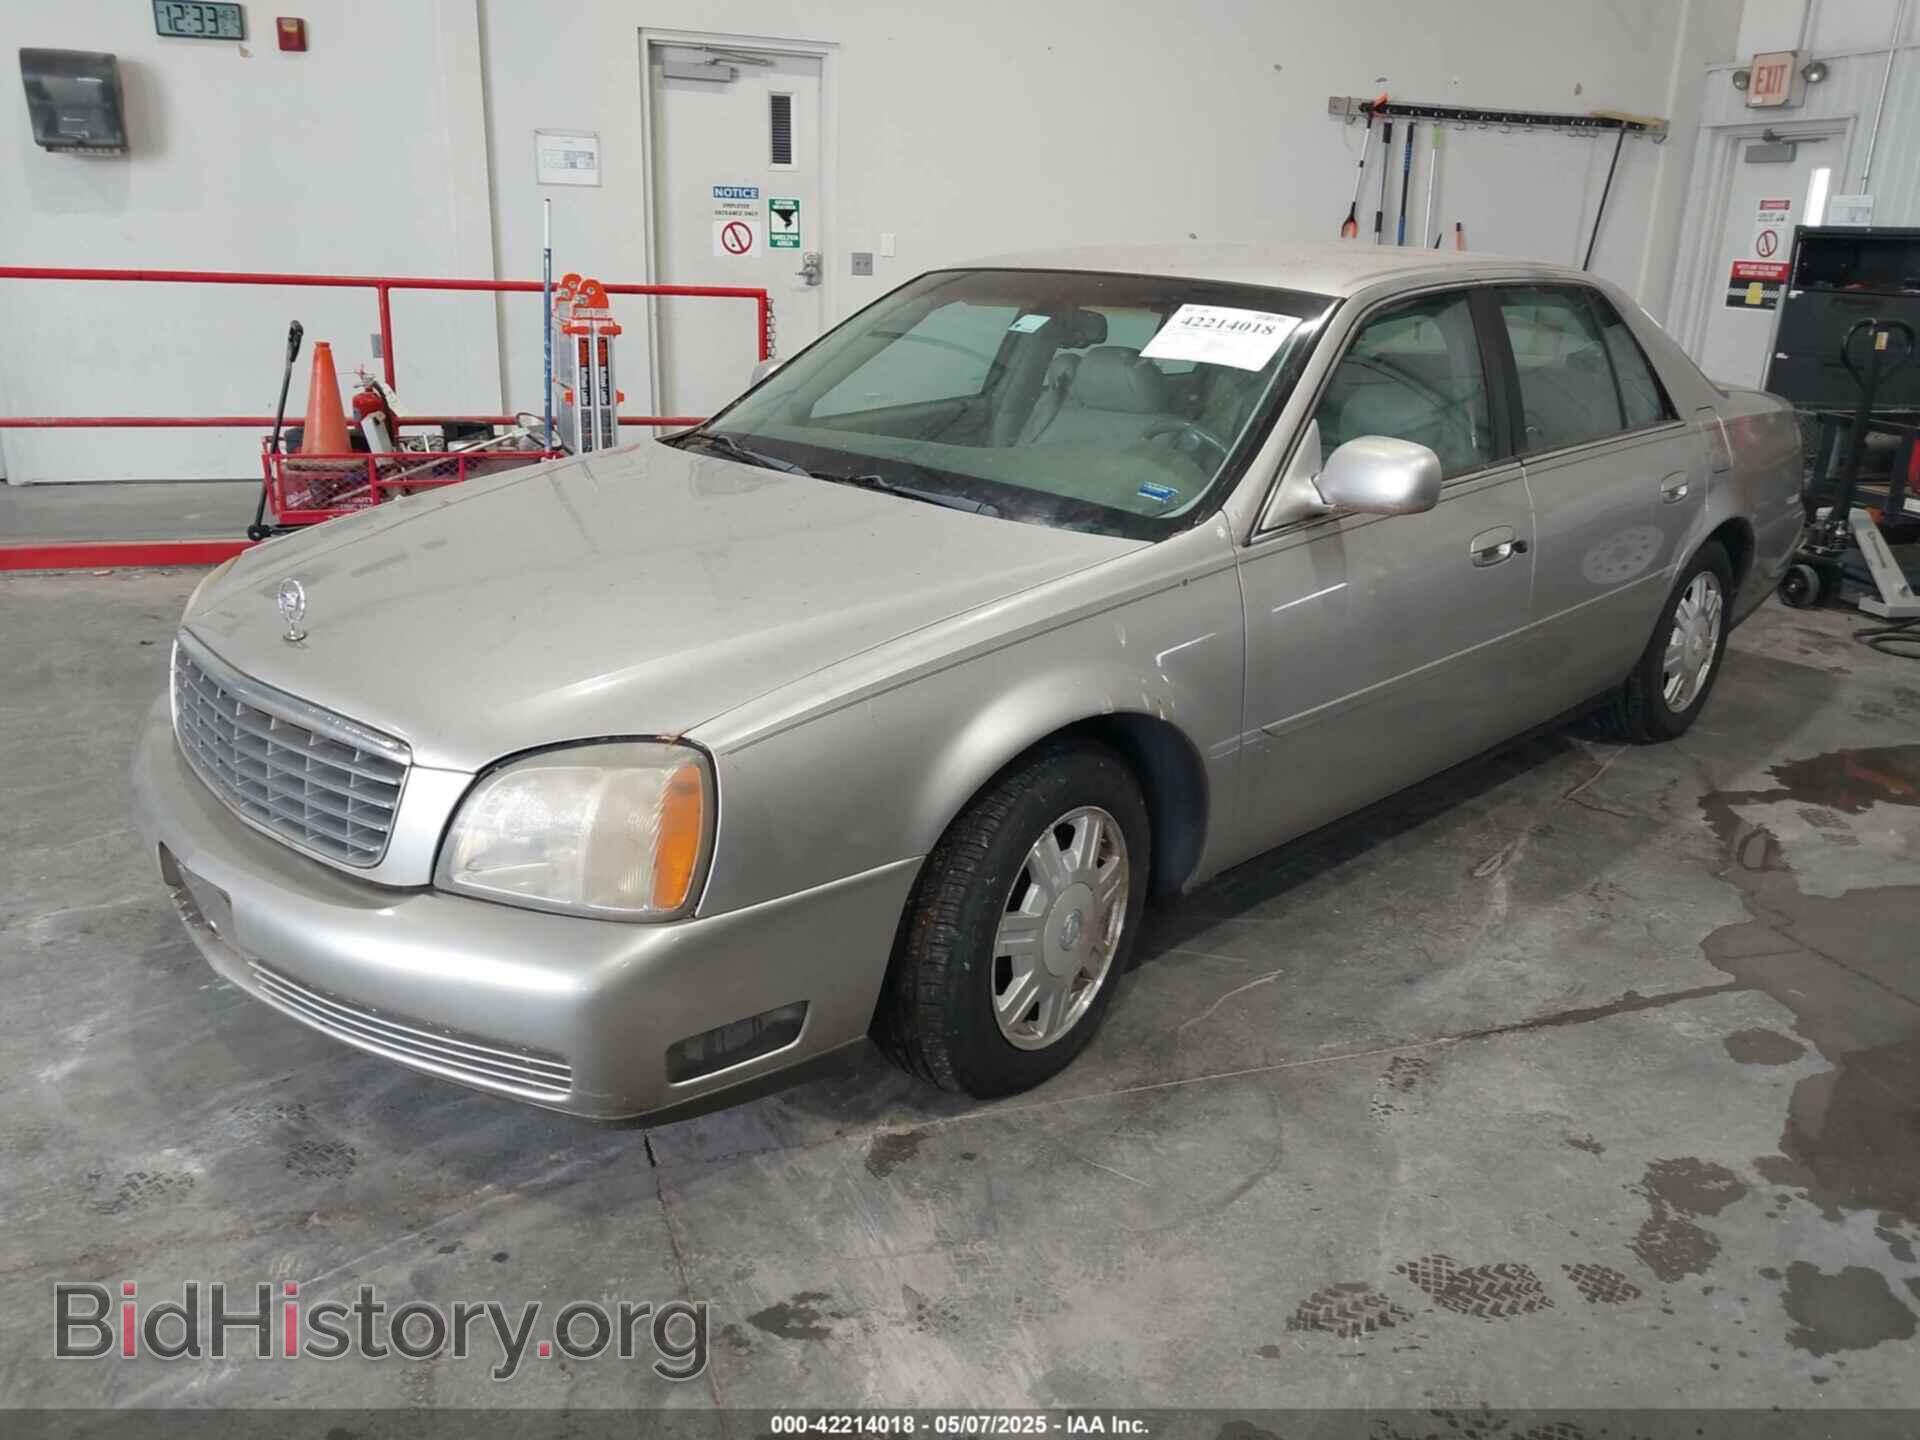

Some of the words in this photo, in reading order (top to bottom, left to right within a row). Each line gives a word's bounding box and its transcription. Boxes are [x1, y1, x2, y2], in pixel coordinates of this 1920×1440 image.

[166, 4, 219, 34] 12:33
[1754, 63, 1787, 95] EXIT
[714, 187, 758, 200] NOTICE
[1180, 316, 1277, 336] 42214018
